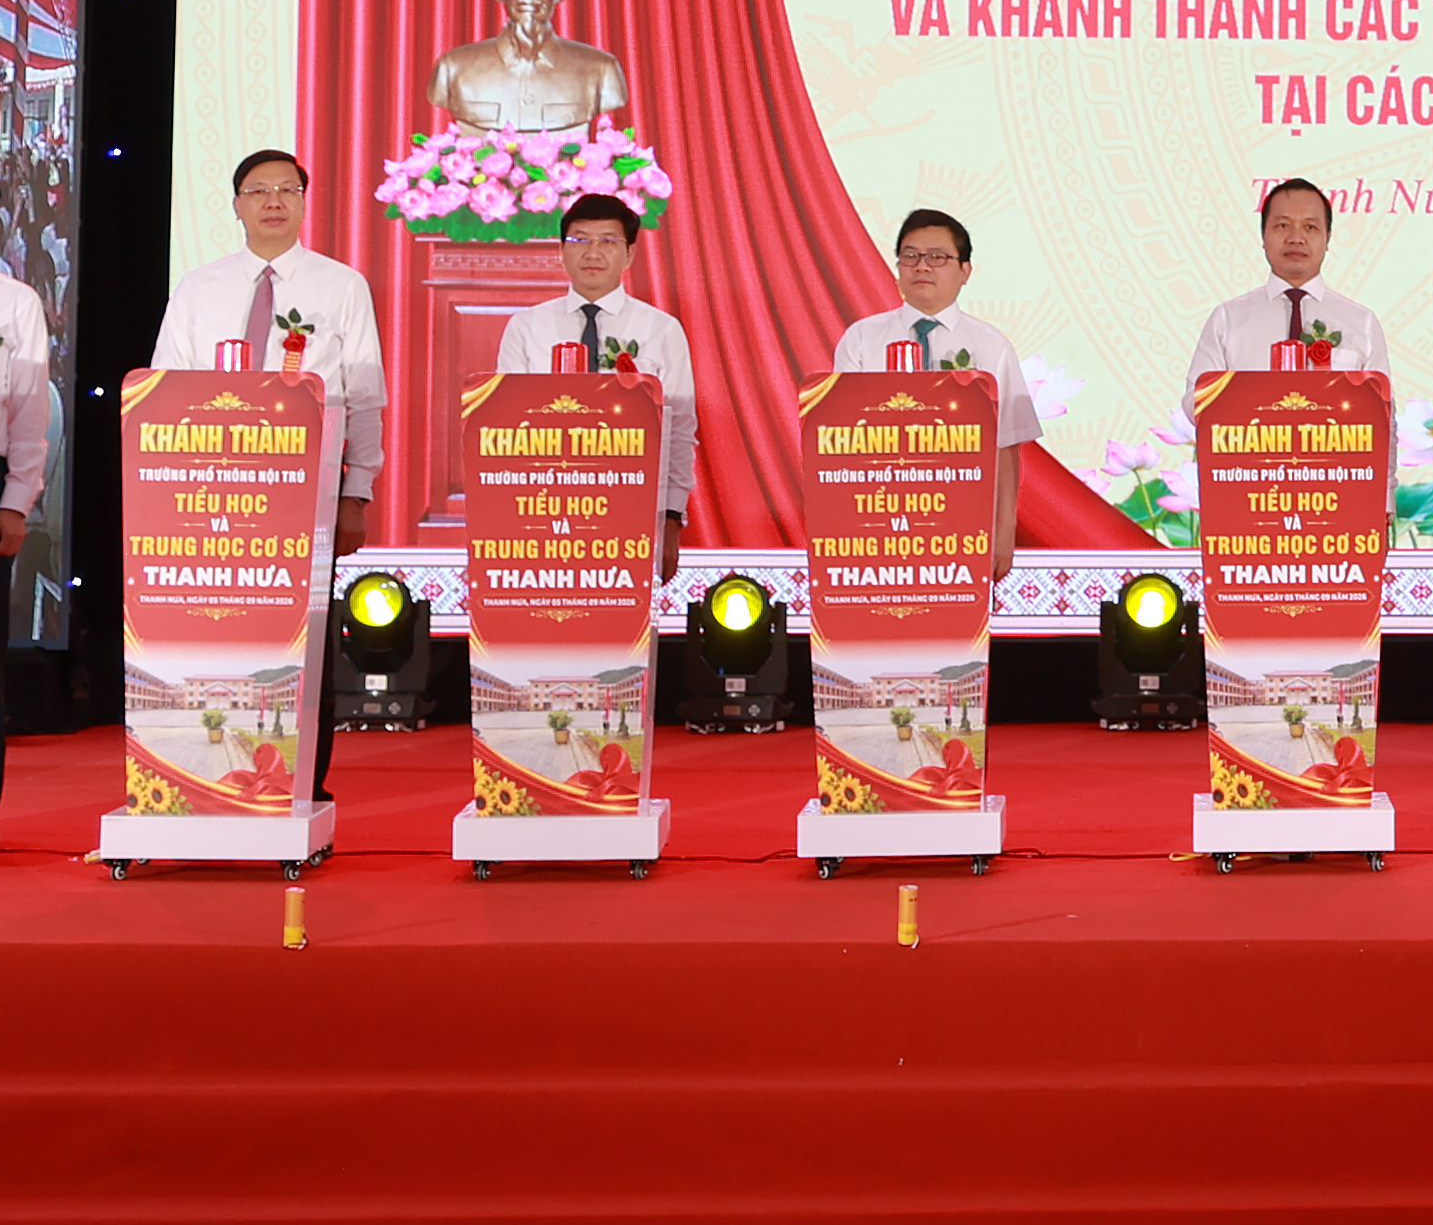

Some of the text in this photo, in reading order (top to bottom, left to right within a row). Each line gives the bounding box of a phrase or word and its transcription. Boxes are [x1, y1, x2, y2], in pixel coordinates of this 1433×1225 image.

[1255, 74, 1327, 137] TẠI
[1252, 177, 1374, 214] Tnh
[139, 416, 307, 455] KHÁNH THÀNH
[479, 421, 645, 456] KHÁNH THÀNH
[817, 418, 981, 454] KHÁNH THÀNH
[1211, 418, 1373, 453] KHÁNH THÀNH
[1212, 464, 1373, 483] TRƯỜNG PHỔ THÔNG NỘI TRÚ
[1248, 484, 1338, 515] TIỂU HỌC
[1284, 514, 1302, 530] VÀ
[1205, 529, 1380, 558] TRUNG HỌC CƠ SỞ
[143, 564, 293, 588] THANH NƯA
[827, 562, 973, 586] THANH NƯA
[1220, 561, 1365, 584] THANH NƯA
